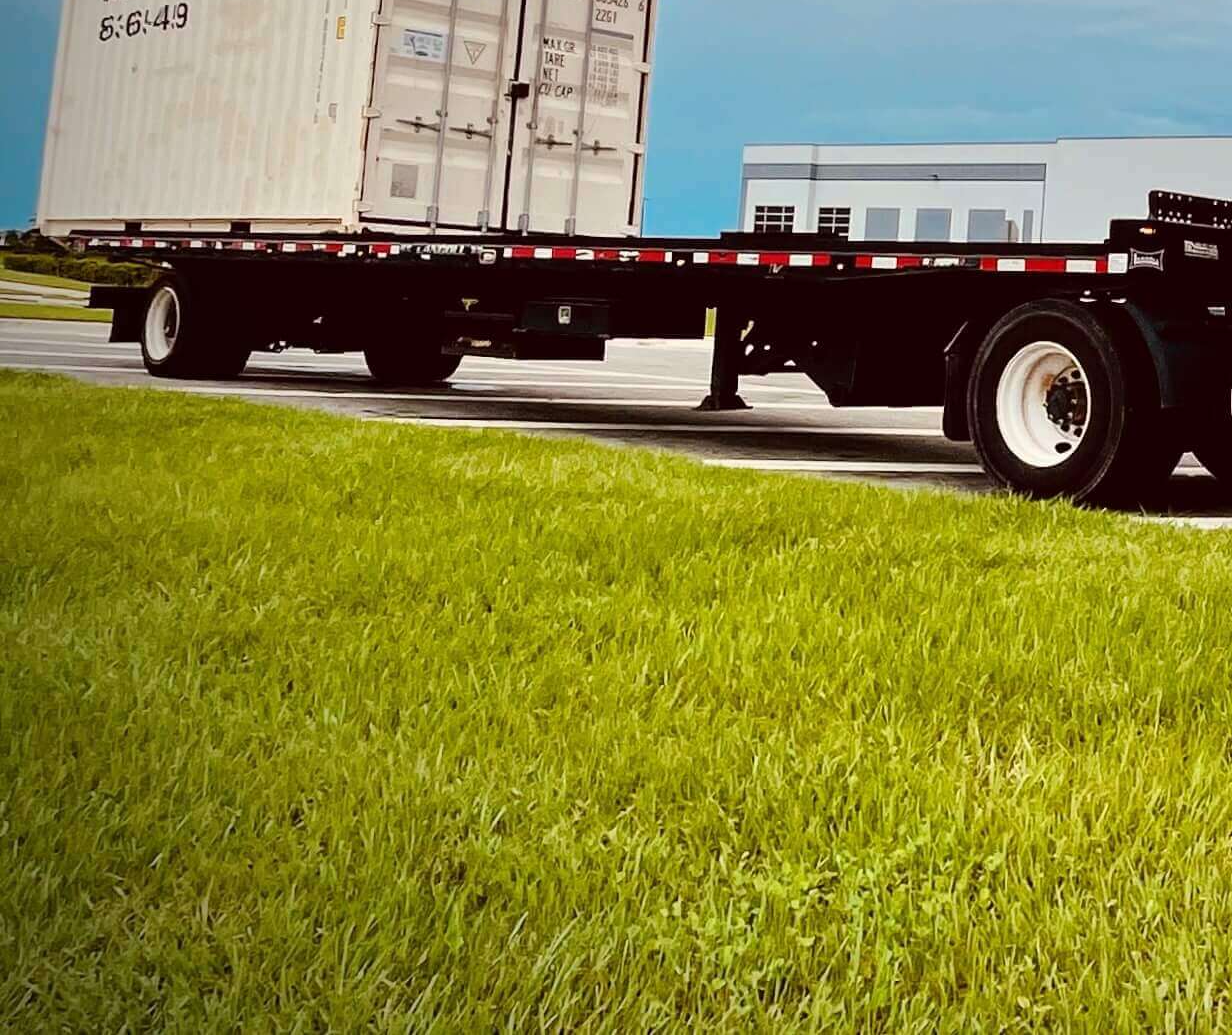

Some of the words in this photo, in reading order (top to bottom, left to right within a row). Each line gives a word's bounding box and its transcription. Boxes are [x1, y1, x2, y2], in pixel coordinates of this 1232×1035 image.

[544, 51, 565, 68] TARE
[543, 68, 559, 82] NET
[554, 85, 573, 98] CAP
